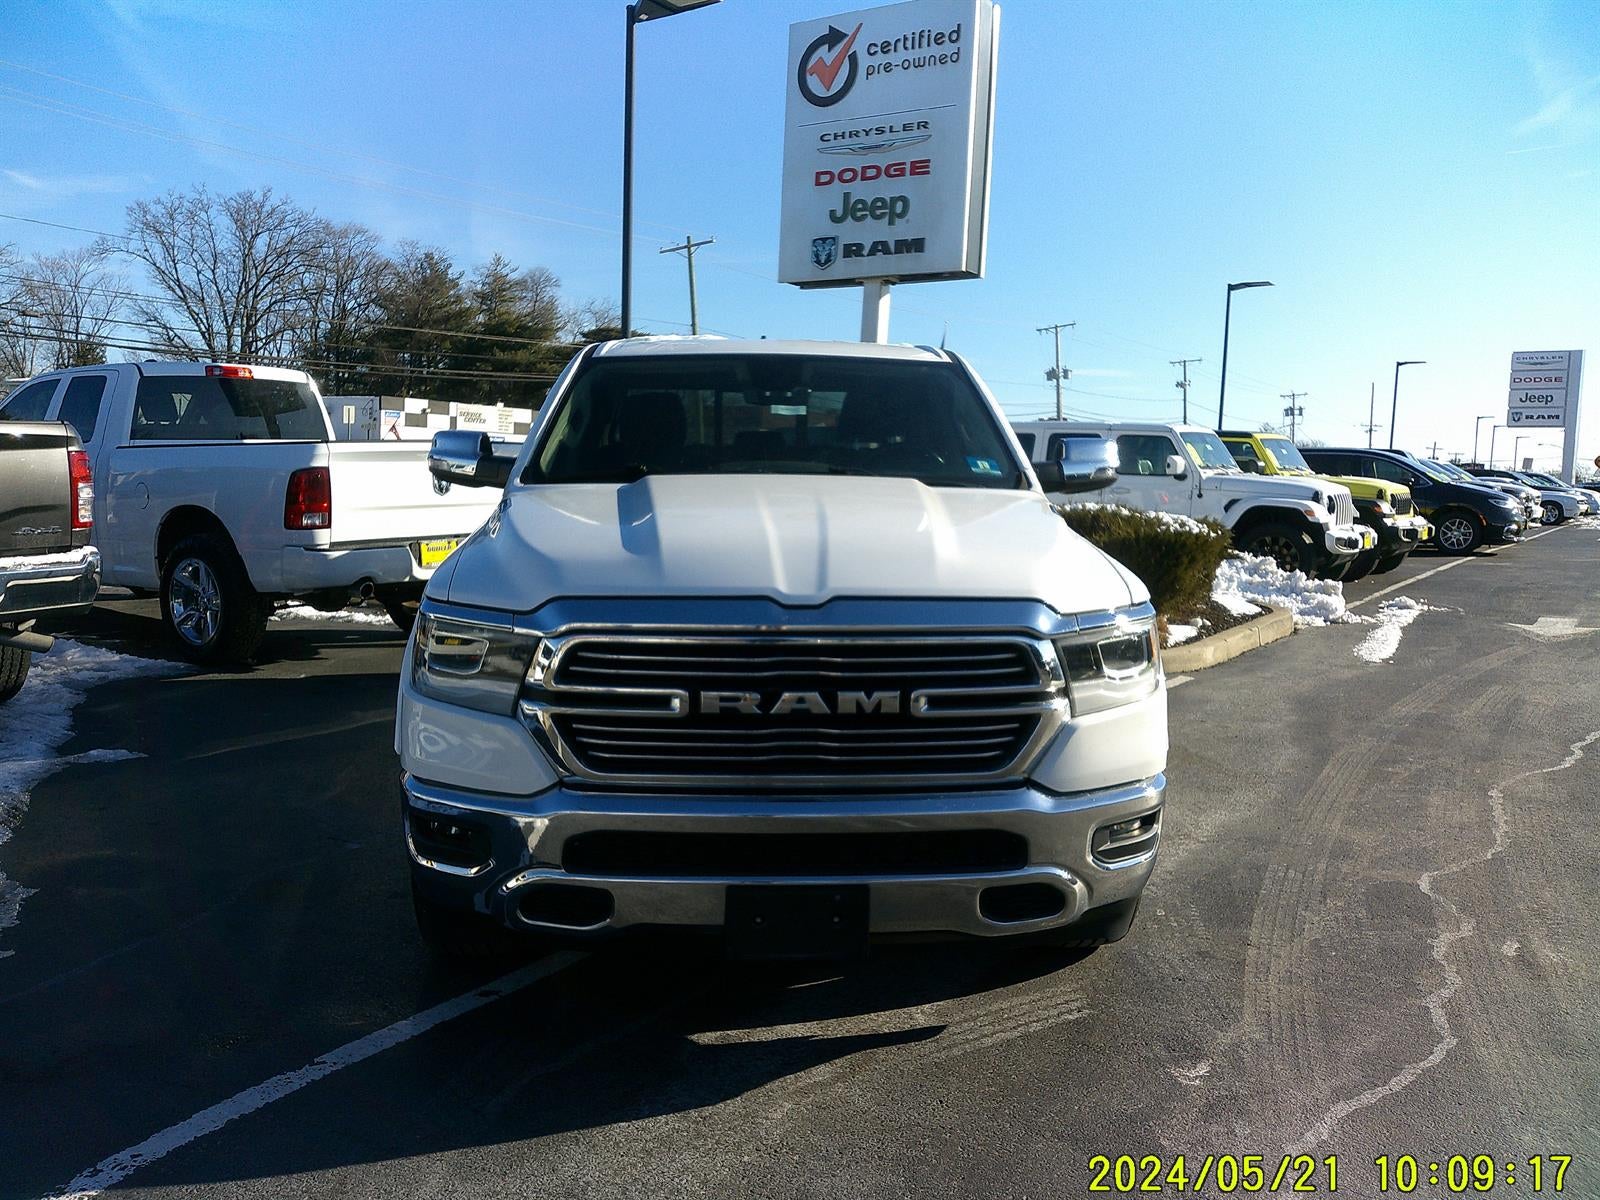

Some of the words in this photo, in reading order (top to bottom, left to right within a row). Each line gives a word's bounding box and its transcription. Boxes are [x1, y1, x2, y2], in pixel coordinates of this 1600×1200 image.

[866, 23, 962, 57] certified
[865, 47, 961, 81] pre-owned
[819, 120, 931, 143] CHRYSLER
[814, 158, 932, 187] DODGE
[828, 191, 911, 227] Jeep
[842, 237, 927, 260] RAM
[1513, 376, 1564, 384] DODGE
[1519, 392, 1554, 405] Jeep
[463, 416, 487, 425] CENTER
[700, 690, 901, 714] RAM
